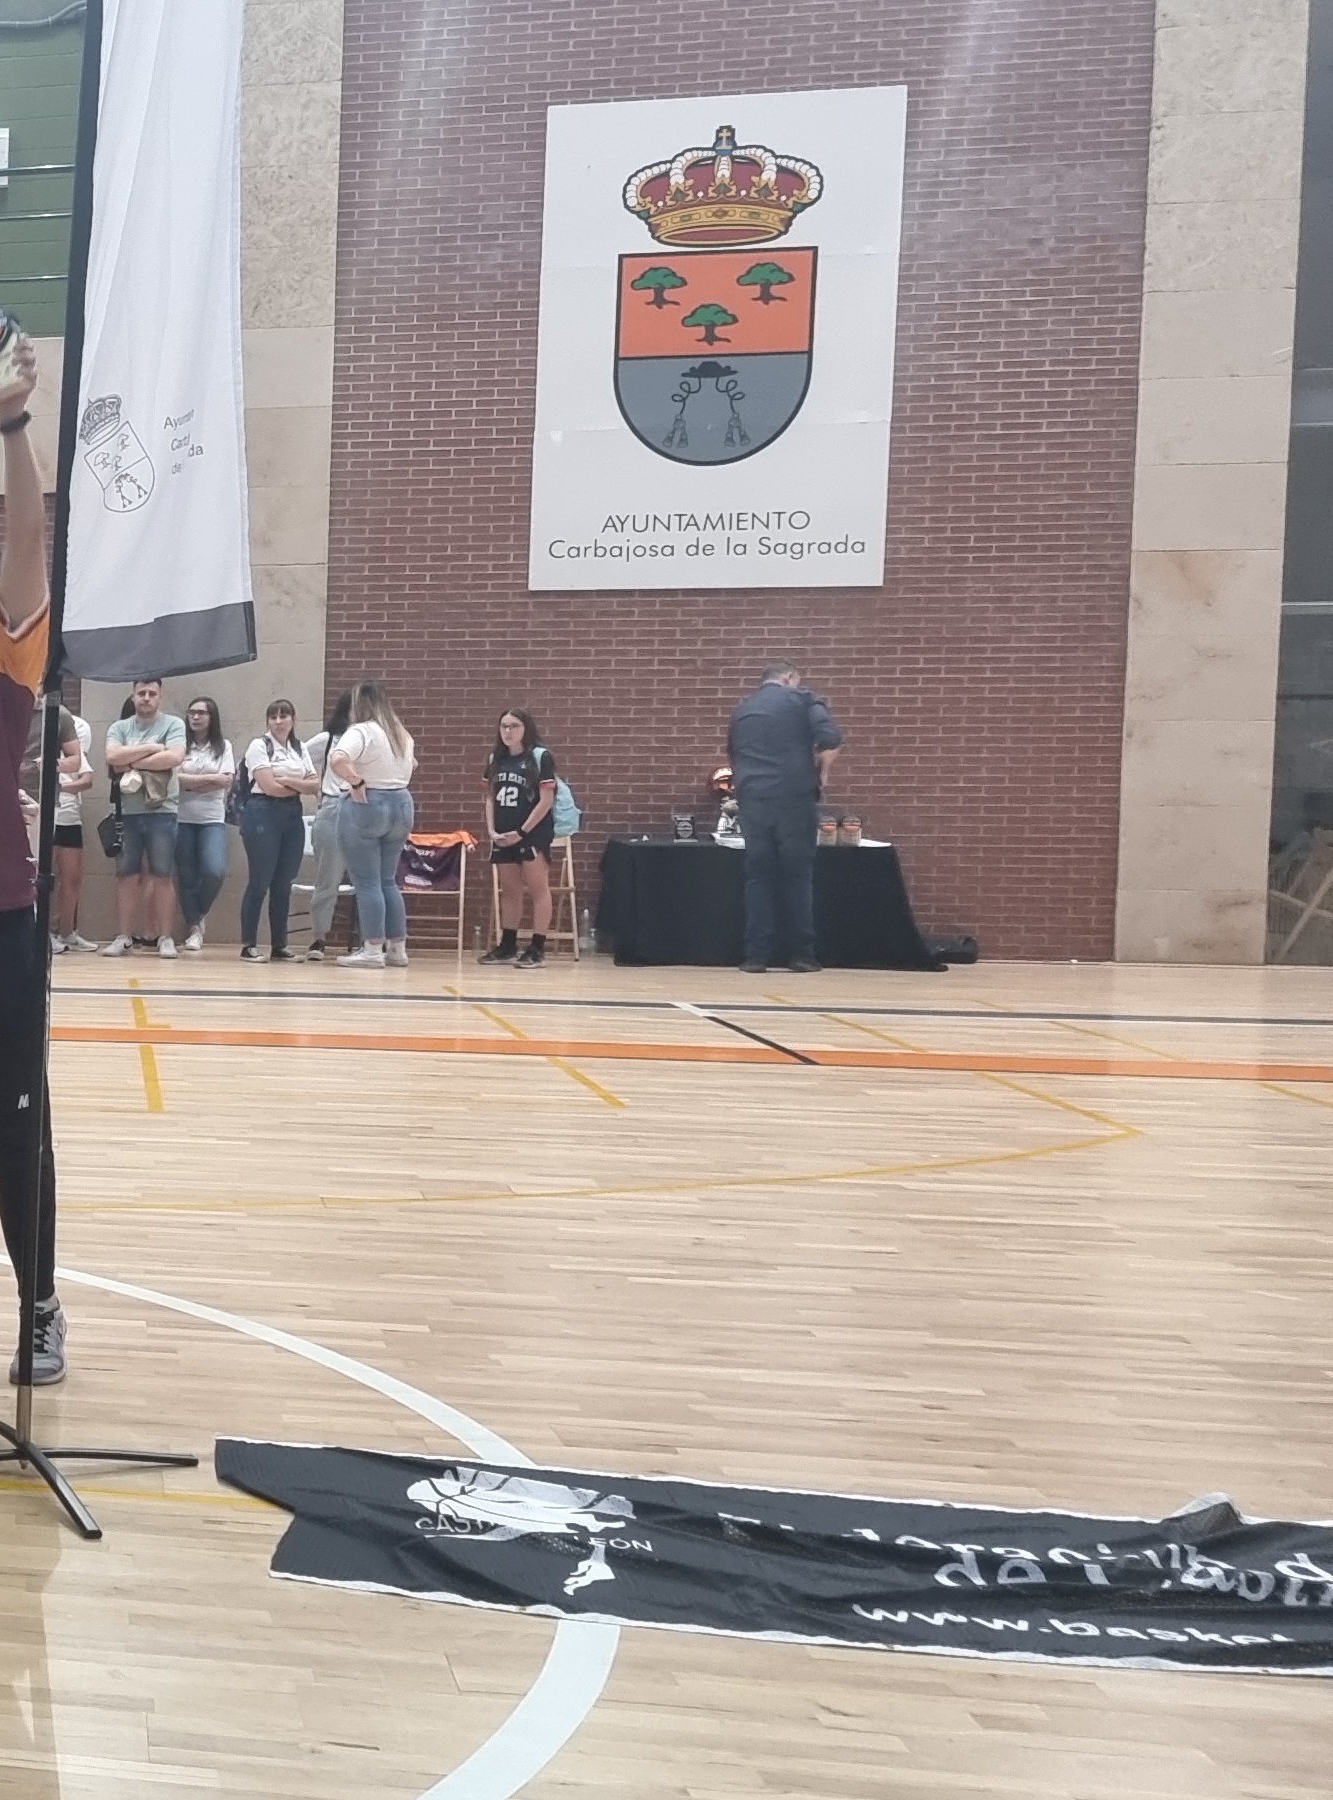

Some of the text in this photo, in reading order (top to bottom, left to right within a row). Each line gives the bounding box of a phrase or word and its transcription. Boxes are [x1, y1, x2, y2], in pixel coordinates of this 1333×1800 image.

[600, 510, 811, 533] AYUNTAMIENTO
[548, 534, 866, 563] Carbajosa de la Sagrada
[496, 786, 519, 807] 42
